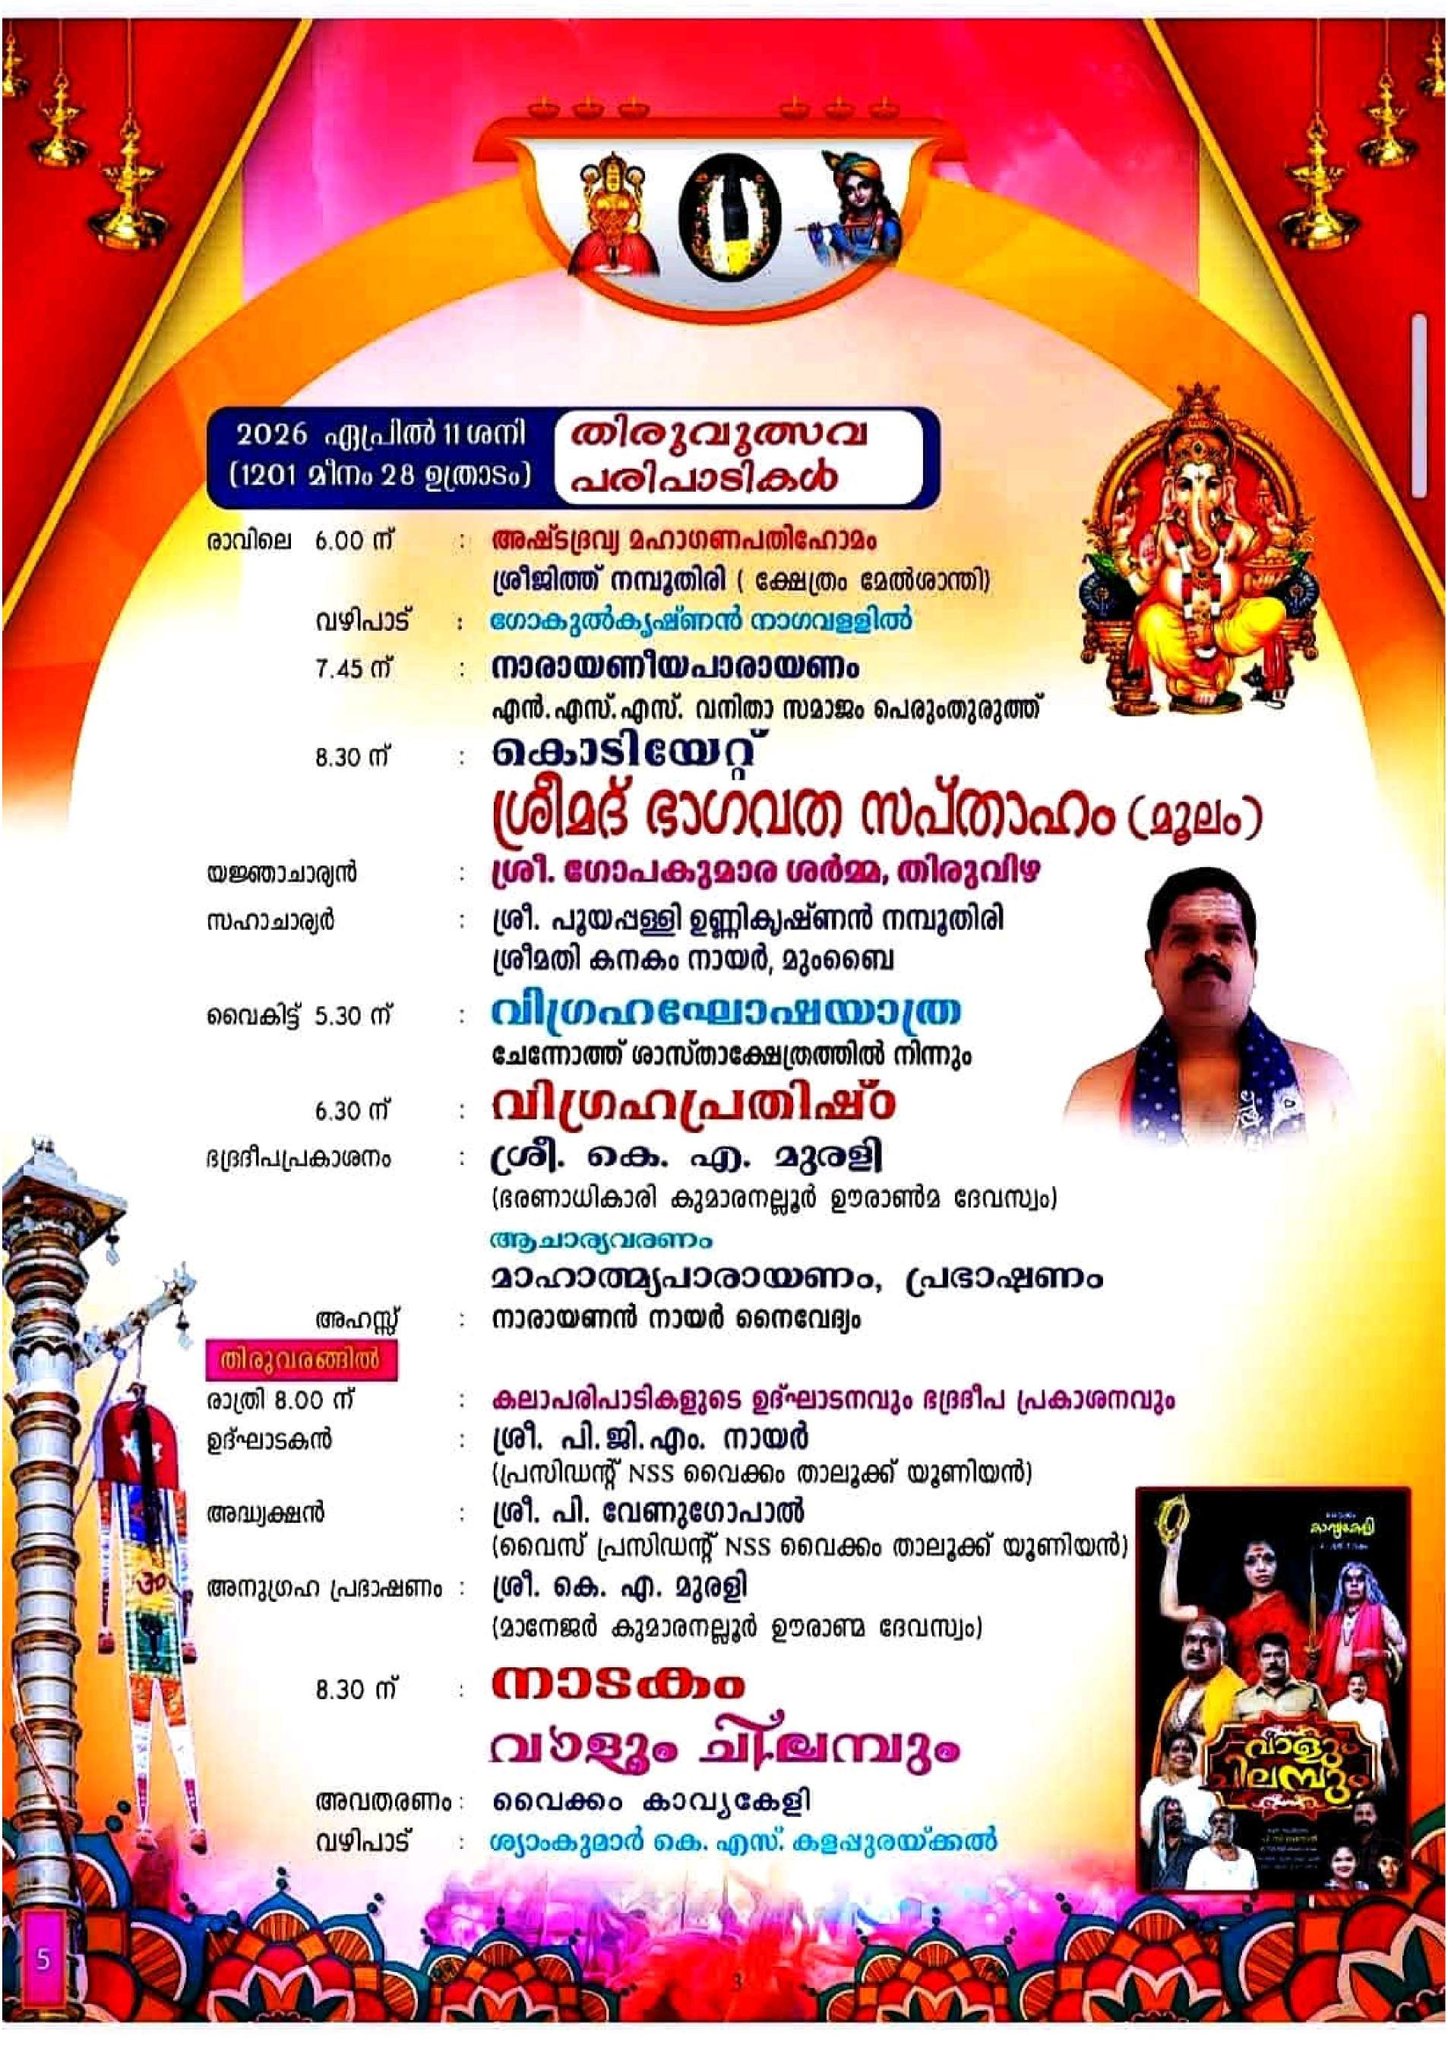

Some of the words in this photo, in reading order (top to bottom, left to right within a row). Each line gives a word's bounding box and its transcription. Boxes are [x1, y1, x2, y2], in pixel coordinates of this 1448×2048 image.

[237, 422, 308, 446] 2026
[324, 418, 436, 451] ഏപ്രിൽ
[443, 423, 460, 446] 11
[466, 417, 526, 446] ശനി
[571, 413, 868, 457] തിരുവുത്സവ
[229, 461, 296, 489] (1201
[308, 458, 373, 487] മീനം
[381, 464, 415, 487] 28
[425, 461, 532, 492] ഉത്രാടം)
[571, 457, 839, 494] പരിപാടികൾ
[208, 526, 292, 551] രാവിലെ
[315, 530, 363, 551] 6.00
[373, 526, 396, 551] ന്
[492, 524, 620, 556] അഷ്ടദ്രവ്യ
[629, 524, 877, 552] മഹാഗണപതിഹോമം
[493, 564, 604, 598] ശ്രീജിത്ത്
[610, 564, 727, 599] നമ്പൂതിരി
[861, 566, 991, 596] മേൽശാന്തി)
[316, 605, 413, 632] വഴിപാട്
[490, 603, 743, 639] ഗോകുൽകൃഷ്ണൻ
[316, 658, 363, 680] 7.45
[371, 654, 395, 680] ന്
[492, 648, 860, 680] നാരായണീയപാരായണം
[695, 693, 775, 720] വനിതാ
[784, 698, 865, 720] സമാജം
[874, 692, 1046, 725] പെരുംതുരുത്ത്
[316, 748, 361, 768] 8.30
[369, 742, 393, 768] ന്
[492, 728, 770, 781] കൊടിയേറ്റ്
[493, 770, 633, 851] ശ്രീമദ്
[646, 789, 842, 839] ഭാഗവത
[862, 774, 1117, 840] സപ്താഹം
[1128, 794, 1264, 847] (മൂലം)
[207, 859, 358, 888] യജ്ഞാചാര്യൻ
[492, 852, 555, 890] ശ്രീ.
[564, 859, 778, 890] ഗോപകുമാര
[897, 852, 1042, 890] തിരുവിഴ
[207, 906, 335, 936] സഹാചാര്യർ
[493, 902, 540, 937] ശ്രീ.
[552, 901, 682, 938] പൂയപ്പള്ളി
[690, 901, 874, 939] ഉണ്ണികൃഷ്ണൻ
[882, 901, 1004, 937] നമ്പൂതിരി
[493, 942, 581, 977] ശ്രീമതി
[589, 948, 680, 972] കനകം
[689, 942, 773, 976] നായർ,
[782, 948, 895, 977] മുംബൈ
[207, 1001, 303, 1031] വൈകിട്ട്
[315, 1005, 361, 1027] 5.30
[370, 1002, 395, 1026] ന്
[491, 986, 962, 1038] വിഗ്രഹഘോഷയാത്ര
[492, 1038, 627, 1068] ചേന്നോത്ത്
[631, 1038, 885, 1071] ശാസ്താക്ഷേത്രത്തിൽ
[893, 1037, 973, 1072] നിന്നും
[316, 1101, 361, 1122] 6.30
[369, 1097, 393, 1121] ന്
[206, 1144, 392, 1173] ഭദ്രദീപപ്രകാശനം
[490, 1135, 565, 1177] ശ്രീ.
[587, 1145, 669, 1169] കെ.
[690, 1145, 751, 1174] എ.
[774, 1135, 883, 1177] മുരളി
[492, 1183, 657, 1212] (ഭരണാധികാരി
[670, 1183, 817, 1216] കുമാരനല്ലൂർ
[831, 1183, 941, 1214] ഊരാൺമ
[954, 1185, 1058, 1212] ദേവസ്വം)
[489, 1230, 714, 1256] ആചാര്യവരണം
[905, 1266, 1104, 1299] പ്രഭാഷണം
[492, 1302, 638, 1330] നാരായണൻ
[649, 1302, 725, 1330] നായർ
[735, 1307, 862, 1335] നൈവേദ്യം
[220, 1346, 381, 1376] തിരുവരങ്ങിൽ
[207, 1386, 265, 1415] രാത്രി
[275, 1390, 324, 1410] 8.00
[333, 1386, 357, 1410] ന്
[492, 1382, 743, 1416] കലാപരിപാടികളുടെ
[751, 1382, 914, 1417] ഉദ്ഘാടനവും
[923, 1382, 1006, 1415] ഭദ്രദീപ
[1016, 1388, 1176, 1417] പ്രകാശനവും
[207, 1426, 333, 1455] ഉദ്ഘാടകൻ
[493, 1420, 544, 1457] ശ്രീ.
[723, 1420, 809, 1451] നായർ
[629, 1463, 675, 1484] NSS
[684, 1463, 786, 1485] വൈക്കം
[796, 1458, 900, 1489] താലൂക്ക്
[907, 1458, 1033, 1490] യൂണിയൻ)
[493, 1494, 540, 1529] ശ്രീ.
[553, 1494, 590, 1524] പി.
[602, 1495, 805, 1530] വേണുഗോപാൽ
[492, 1531, 588, 1560] (വൈസ്
[725, 1537, 772, 1558] NSS
[780, 1536, 883, 1558] വൈക്കം
[892, 1531, 995, 1563] താലൂക്ക്
[1003, 1531, 1129, 1563] യൂണിയൻ)
[207, 1578, 320, 1602] അനുഗ്രഹ
[330, 1578, 443, 1603] പ്രഭാഷണം
[493, 1569, 541, 1603] ശ്രീ.
[553, 1574, 607, 1598] കെ.
[620, 1574, 662, 1603] എ.
[675, 1568, 748, 1604] മുരളി
[492, 1612, 598, 1641] (മാനേജർ
[610, 1612, 758, 1646] കുമാരനല്ലൂർ
[879, 1614, 983, 1642] ദേവസ്വം)
[316, 1679, 365, 1700] 8.30
[375, 1674, 400, 1700] ന്
[491, 1666, 747, 1701] നാടകം
[493, 1791, 623, 1812] വൈക്കം
[642, 1786, 811, 1821] കാവ്യകേളി
[316, 1827, 414, 1853] വഴിപാട്
[490, 1824, 644, 1859] ശ്യാംകുമാർ
[653, 1832, 709, 1853] കെ.
[792, 1824, 999, 1860] കളപ്പുരയ്ക്കൽ
[36, 1947, 51, 1971] 5
